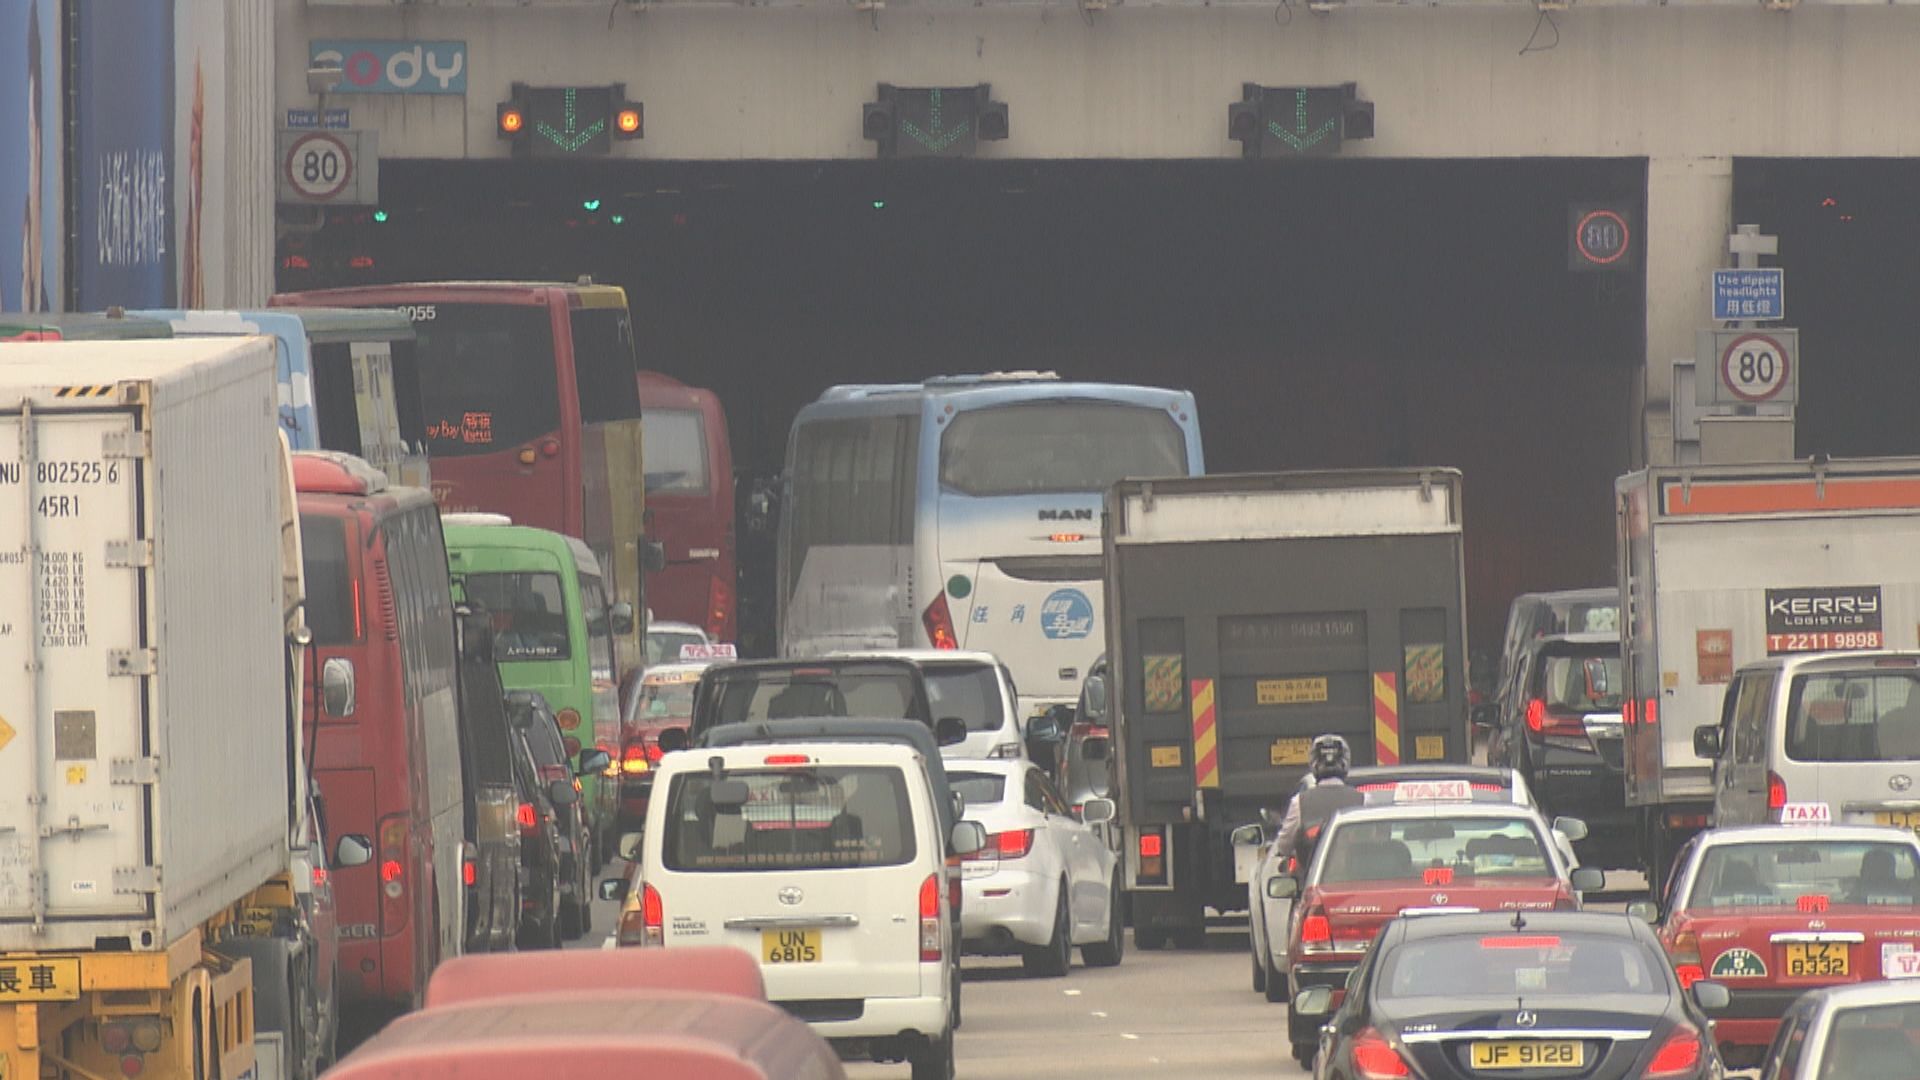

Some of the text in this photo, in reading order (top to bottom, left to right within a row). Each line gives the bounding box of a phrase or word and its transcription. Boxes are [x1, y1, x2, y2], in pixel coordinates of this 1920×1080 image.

[303, 151, 338, 182] 80
[1718, 274, 1778, 287] Use dipped
[1719, 286, 1777, 298] headlights
[1727, 300, 1771, 314] 用低燈
[1740, 351, 1774, 384] 80
[0, 462, 118, 483] NU 802525 6
[38, 496, 79, 517] 45R1
[1038, 508, 1092, 520] MAN
[1769, 596, 1877, 615] KERRY
[1784, 615, 1864, 625] LOGISTICS
[1771, 632, 1878, 651] T 2211 9898
[684, 646, 732, 657] TAXI
[1402, 783, 1464, 798] TAXI
[1787, 806, 1827, 819] TAXI
[779, 931, 805, 946] UN
[770, 946, 816, 963] 6815
[1805, 943, 1829, 960] LZ
[1792, 959, 1844, 975] 8332
[1897, 955, 1920, 973] T
[1480, 1044, 1573, 1063] JF 9128
